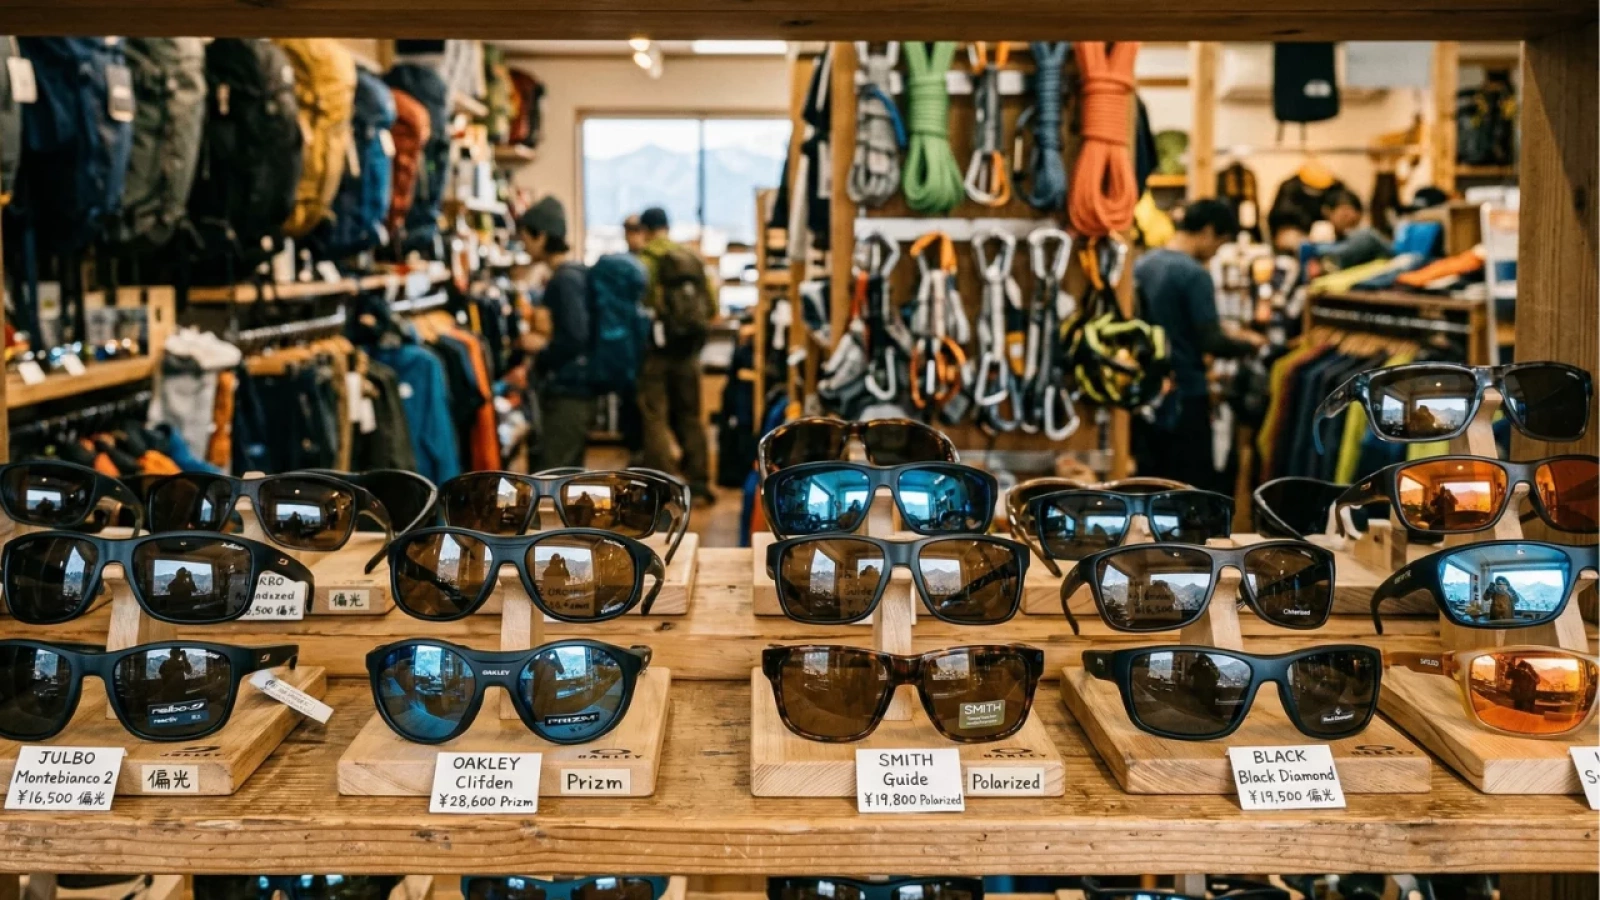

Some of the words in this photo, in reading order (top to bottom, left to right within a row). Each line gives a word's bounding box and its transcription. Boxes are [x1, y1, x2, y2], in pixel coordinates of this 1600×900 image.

[964, 703, 1002, 715] SMITH
[547, 714, 596, 725] PRIZM
[38, 751, 96, 765] JULBO
[453, 756, 521, 771] OAKLEY
[879, 753, 934, 767] SMITH
[1253, 749, 1307, 764] BLACK
[15, 770, 101, 785] Montebianco
[104, 771, 114, 785] 2
[147, 769, 191, 790] 偏光
[455, 775, 514, 790] Clifden
[567, 773, 623, 790] Prizm
[883, 772, 929, 787] Guide
[972, 773, 1041, 790] Polarized
[1238, 770, 1276, 785] Black
[1278, 766, 1336, 782] Diamond
[17, 790, 73, 805] ¥16,500
[77, 791, 106, 806] 偏光
[439, 793, 496, 809] ¥28,600
[500, 796, 534, 807] Prizm
[864, 792, 917, 808] ¥19,800
[920, 794, 962, 806] Polarized
[1249, 789, 1302, 804] ¥19,500
[1305, 788, 1336, 802] 偏光
